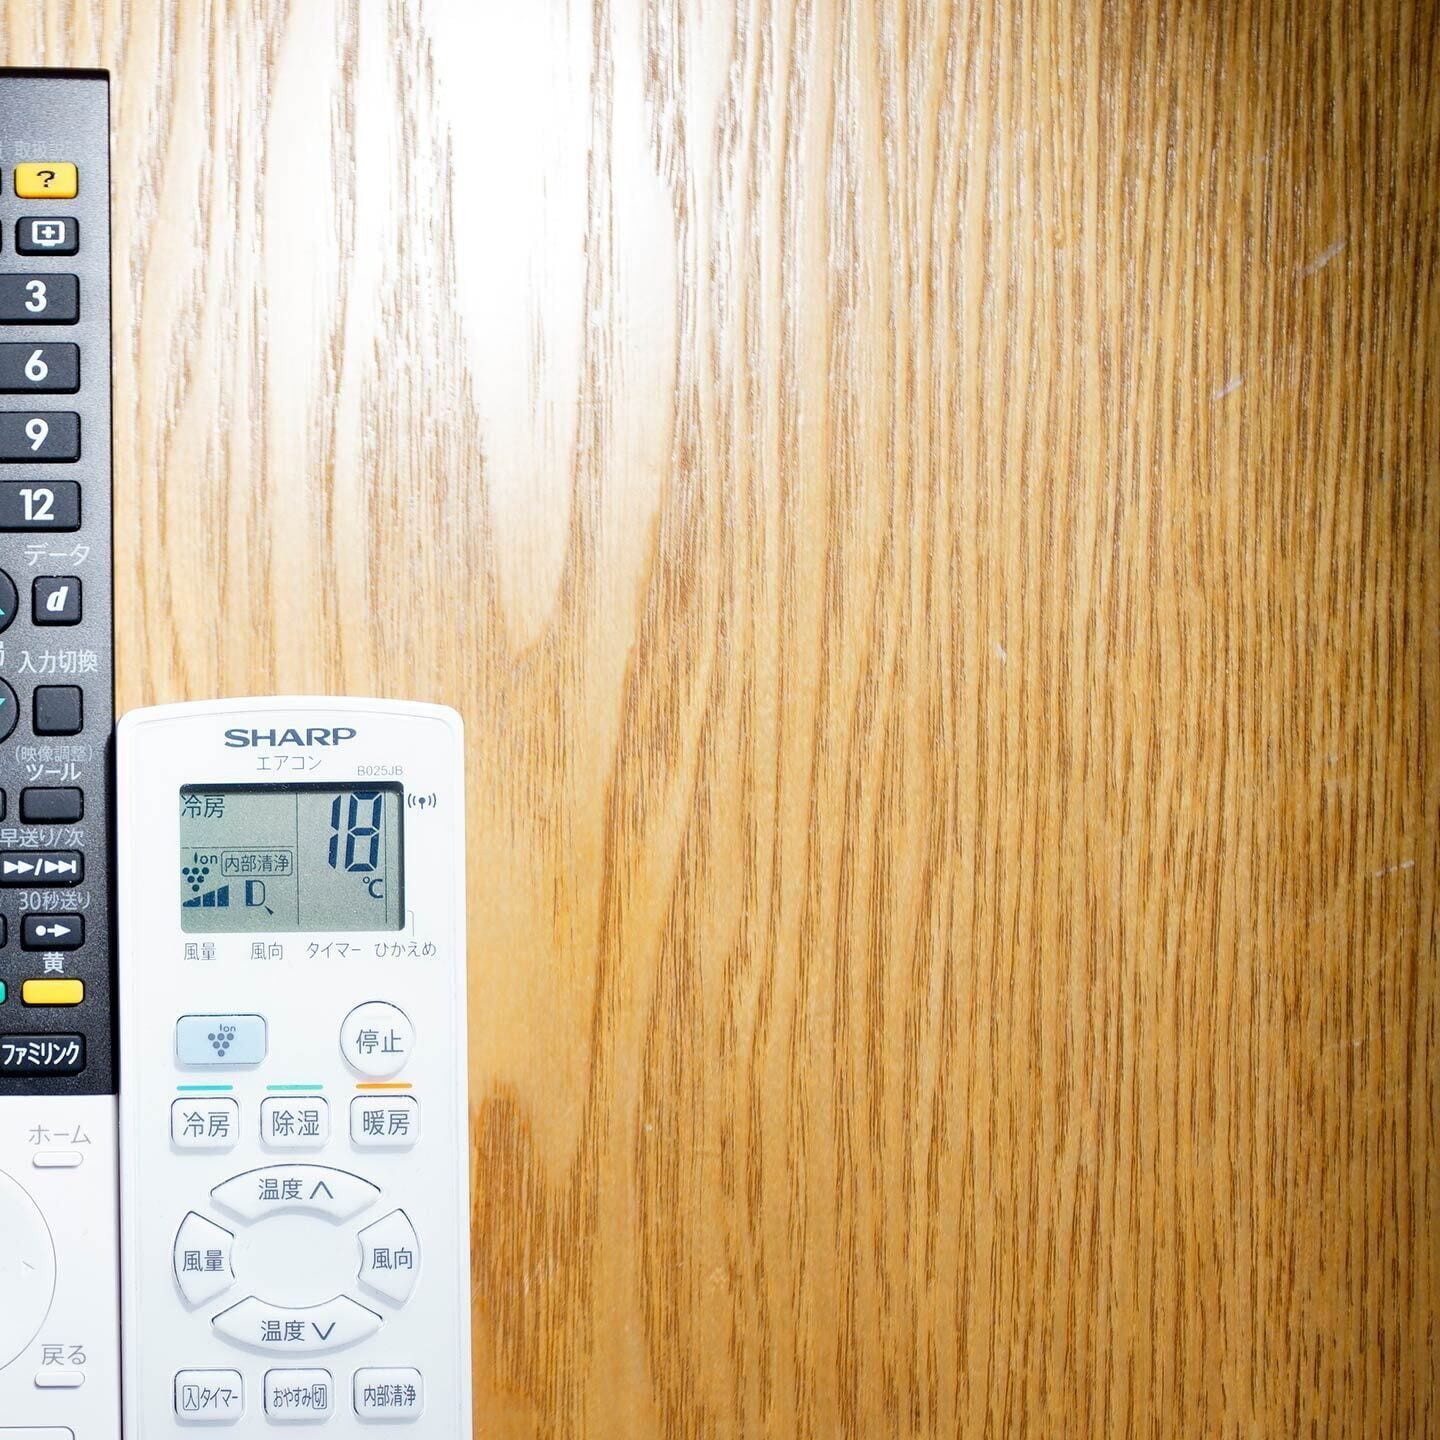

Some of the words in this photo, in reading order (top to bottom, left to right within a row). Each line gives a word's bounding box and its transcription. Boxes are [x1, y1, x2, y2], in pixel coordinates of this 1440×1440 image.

[25, 280, 47, 312] 3
[24, 350, 48, 381] 6
[25, 418, 48, 451] 9
[19, 488, 54, 520] 12
[23, 543, 90, 566] データ
[46, 586, 68, 611] d
[18, 650, 98, 673] 入力切換
[224, 728, 357, 747] SHARP
[26, 763, 81, 781] ツール
[256, 756, 322, 772] エアコン
[357, 765, 403, 776] B025JB
[180, 793, 225, 819] 冷房
[0, 829, 84, 847] 早送り/次
[328, 792, 383, 872] 18
[224, 855, 289, 872] 内部清浄
[19, 892, 91, 910] 30秒送り
[183, 943, 216, 961] 風量
[250, 942, 283, 961] 風向
[306, 943, 361, 959] タイマー
[374, 942, 437, 958] ひかえめ
[43, 953, 64, 973] 黄
[356, 1029, 404, 1054] 停止
[1, 1041, 80, 1066] ファミリンク
[182, 1111, 230, 1137] 冷房
[272, 1110, 320, 1137] 除湿
[362, 1109, 410, 1136] 暖房
[28, 1125, 92, 1145] ホーム
[258, 1178, 303, 1200] 温度
[182, 1251, 224, 1272] 風量
[372, 1248, 413, 1270] 風向
[261, 1320, 305, 1342] 温度
[41, 1344, 87, 1366] 戻る
[363, 1384, 416, 1407] 内部清浄
